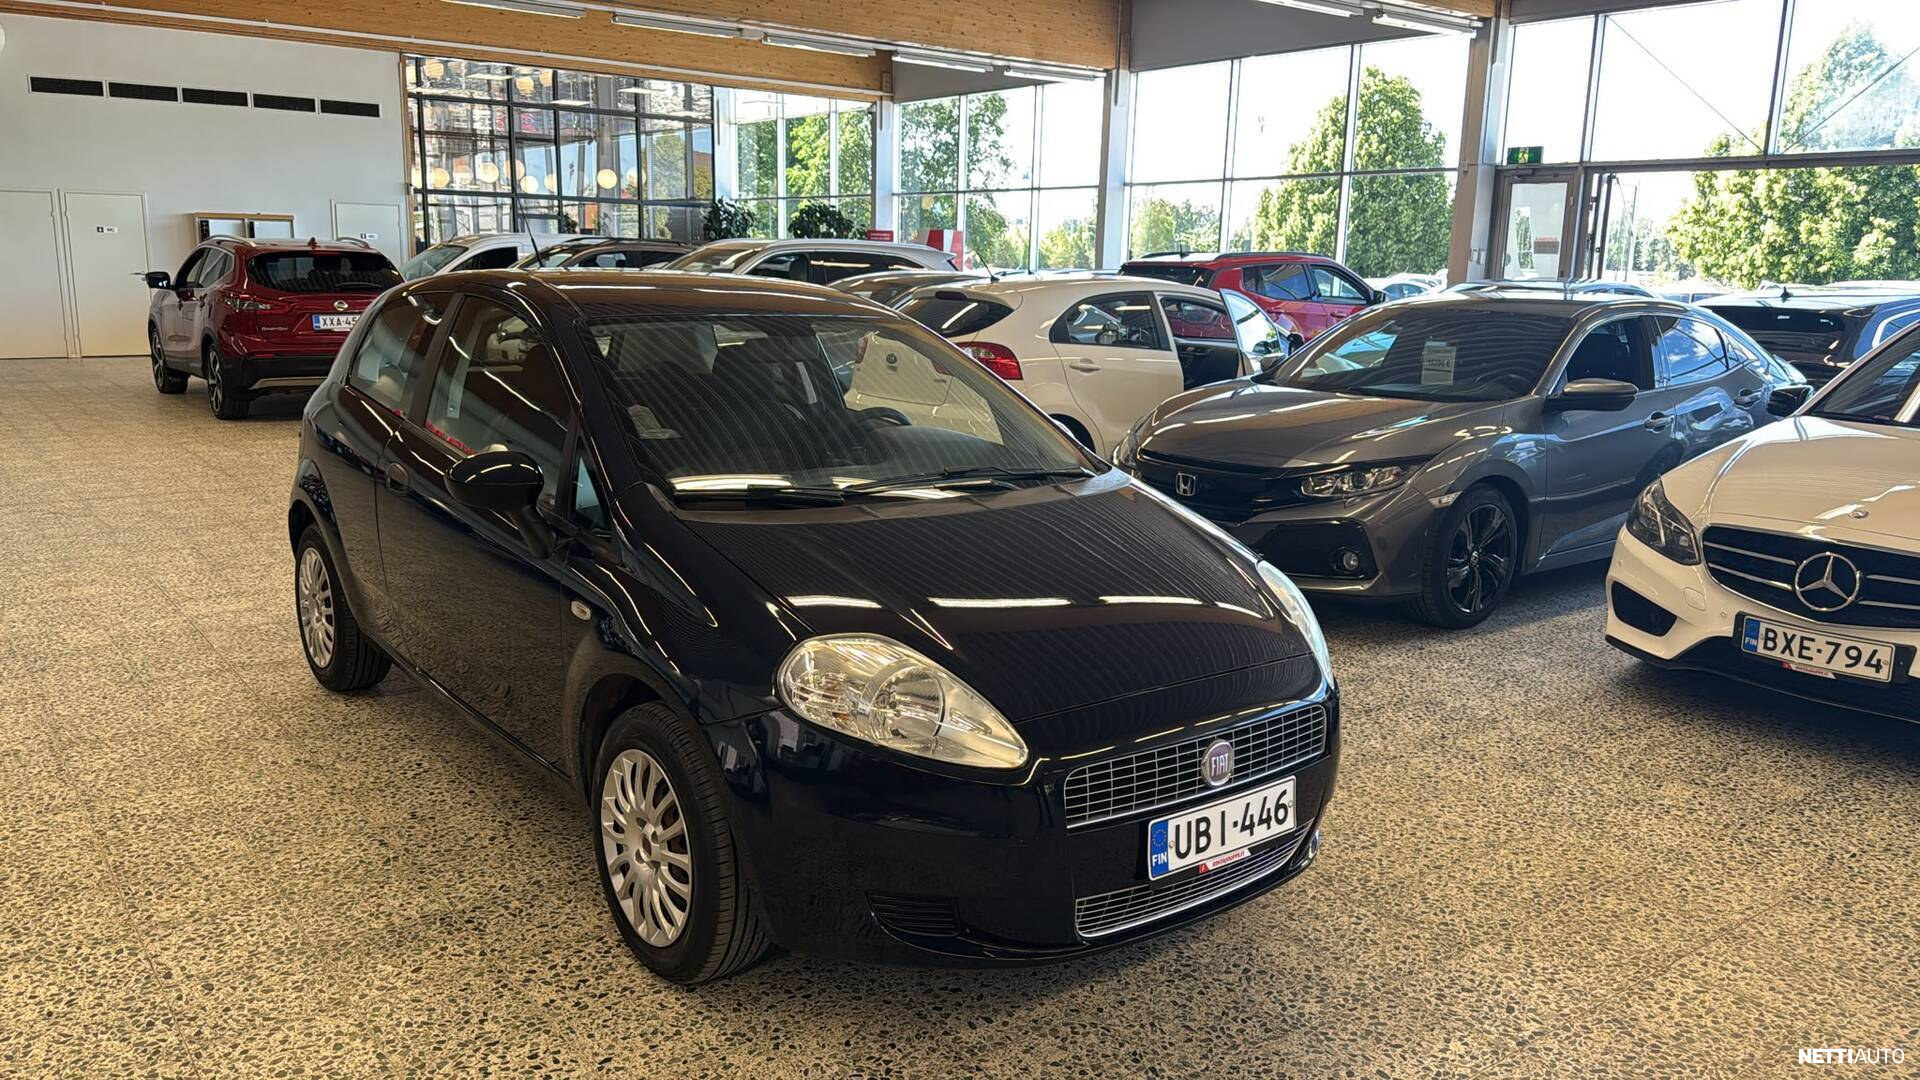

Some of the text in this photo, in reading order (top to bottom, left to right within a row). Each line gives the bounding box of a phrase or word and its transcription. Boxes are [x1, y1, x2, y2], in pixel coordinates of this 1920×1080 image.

[1763, 627, 1883, 674] BXE-794
[1211, 753, 1229, 777] FIAT
[1175, 789, 1289, 860] UBI-446
[1152, 851, 1168, 867] FIN
